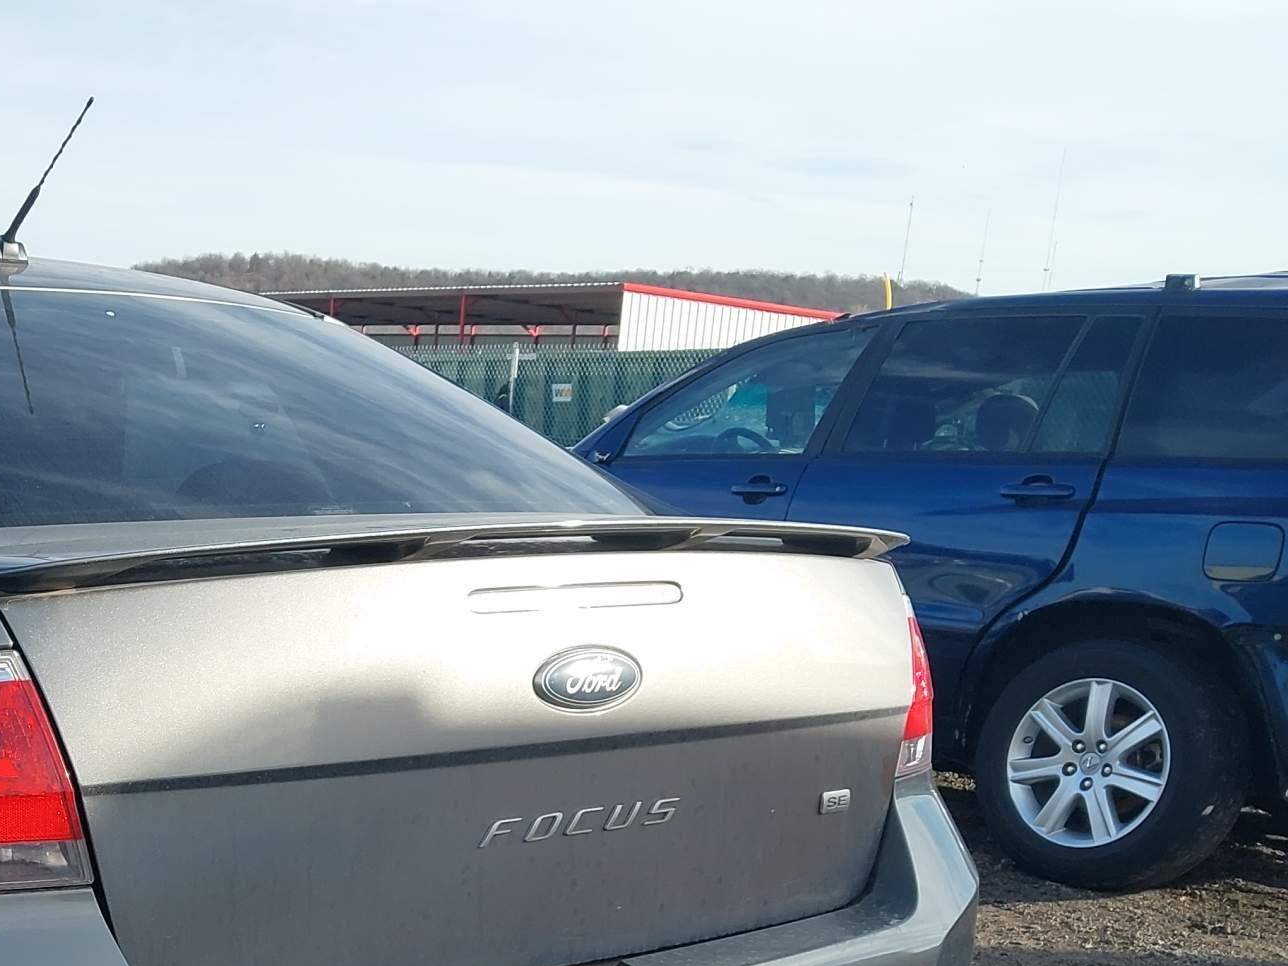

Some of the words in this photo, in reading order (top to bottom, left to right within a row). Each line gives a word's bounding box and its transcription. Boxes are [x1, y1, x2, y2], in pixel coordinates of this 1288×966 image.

[565, 665, 624, 694] Ford
[826, 794, 848, 808] SE
[478, 797, 681, 848] FOCUS
